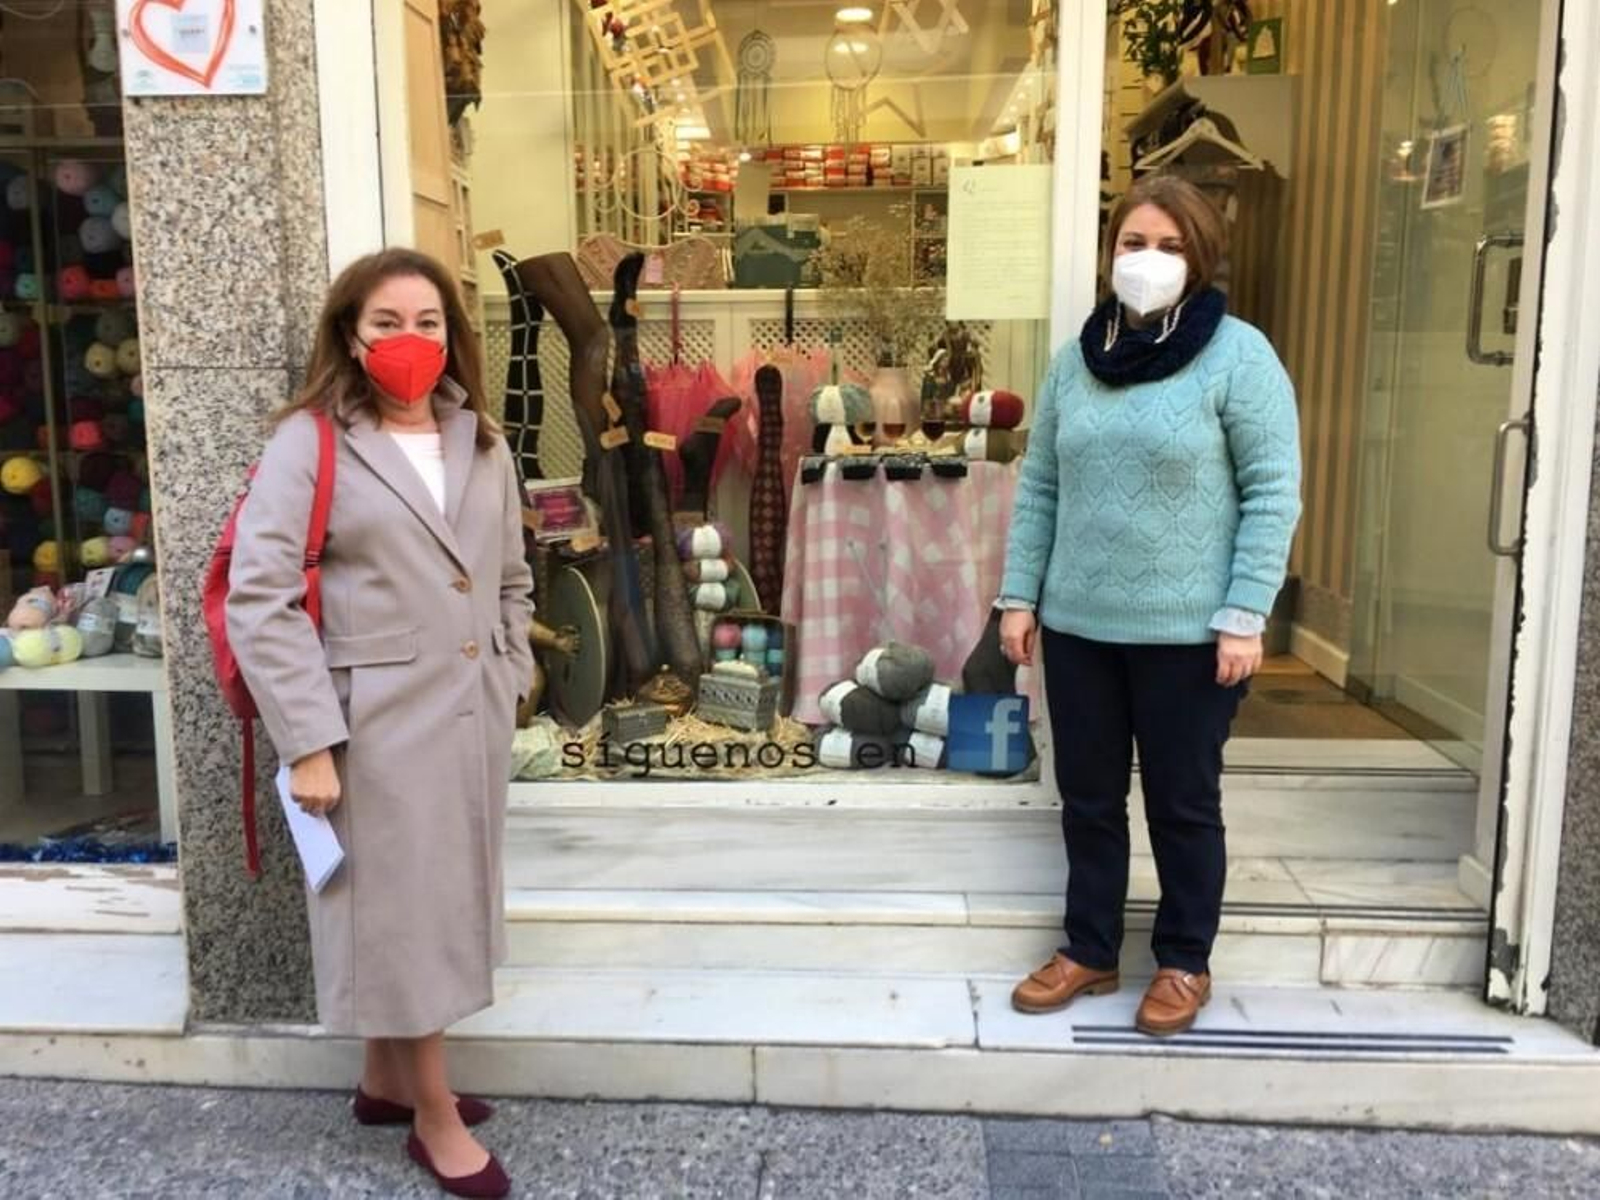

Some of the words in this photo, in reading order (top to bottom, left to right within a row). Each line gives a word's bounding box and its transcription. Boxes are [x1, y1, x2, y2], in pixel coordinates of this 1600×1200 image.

[561, 732, 816, 777] síguenos
[856, 742, 916, 768] en
[984, 697, 1024, 771] f
